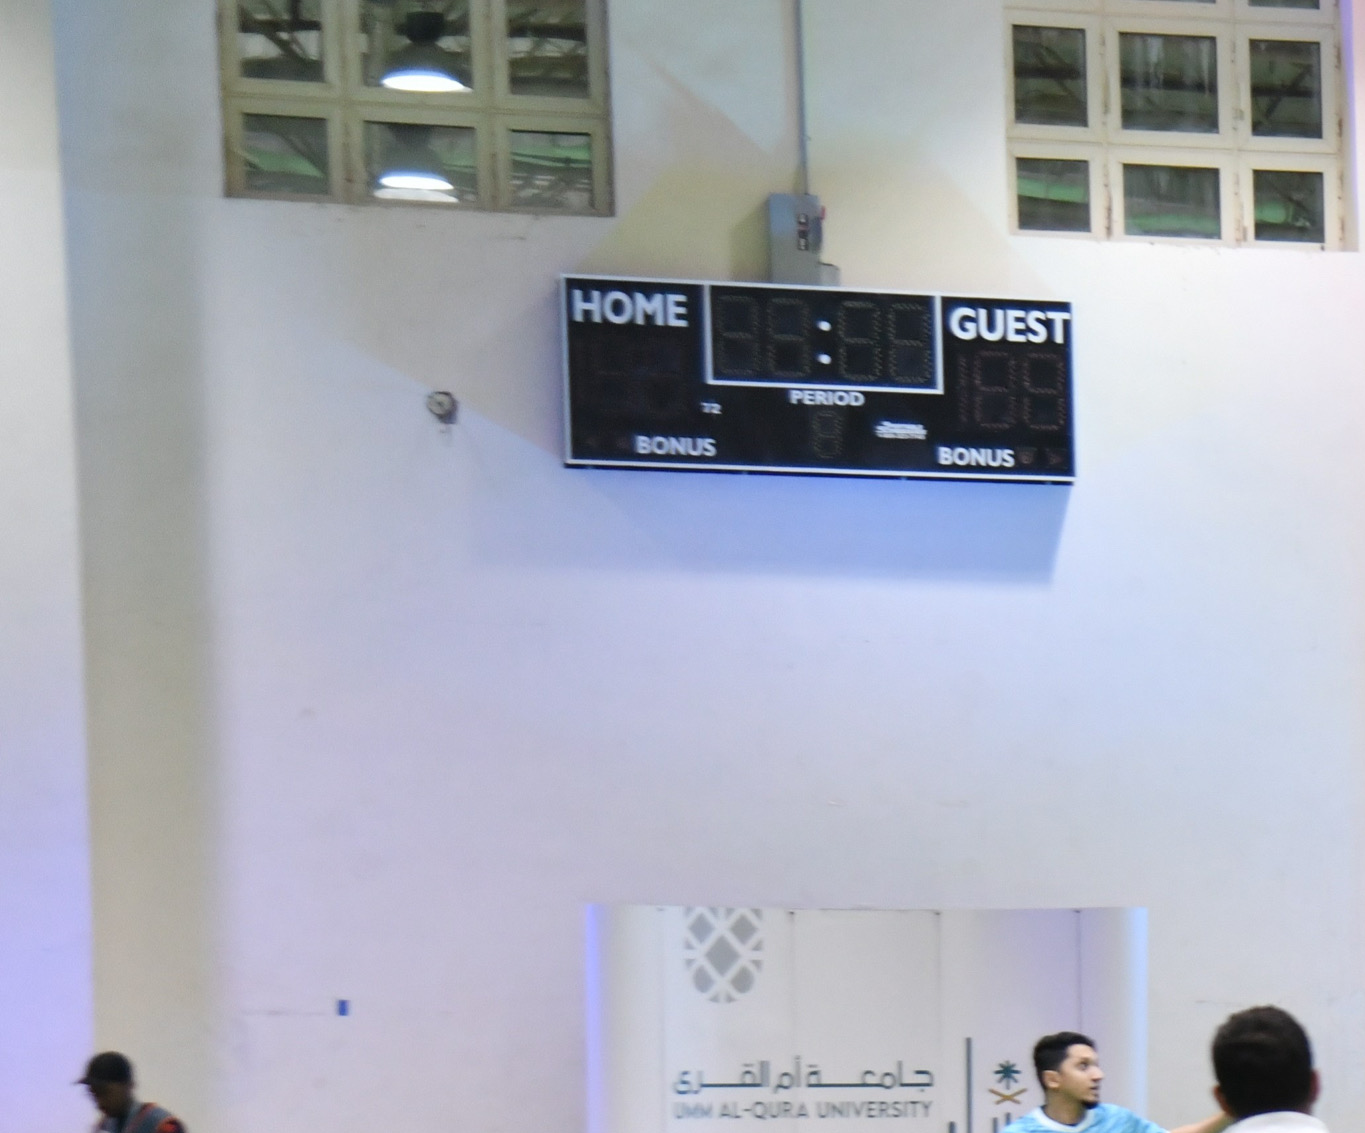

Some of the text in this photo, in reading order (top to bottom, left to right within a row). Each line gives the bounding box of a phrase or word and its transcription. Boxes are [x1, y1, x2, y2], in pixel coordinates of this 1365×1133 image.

[571, 288, 690, 329] HOME
[947, 306, 1071, 345] GUEST
[788, 388, 866, 407] PERIOD
[634, 434, 717, 458] BONUS
[936, 446, 1016, 468] BONUS
[673, 1055, 935, 1095] جامعة أم القرى
[674, 1100, 933, 1121] UMM AL-QURA UNIVERSITY
